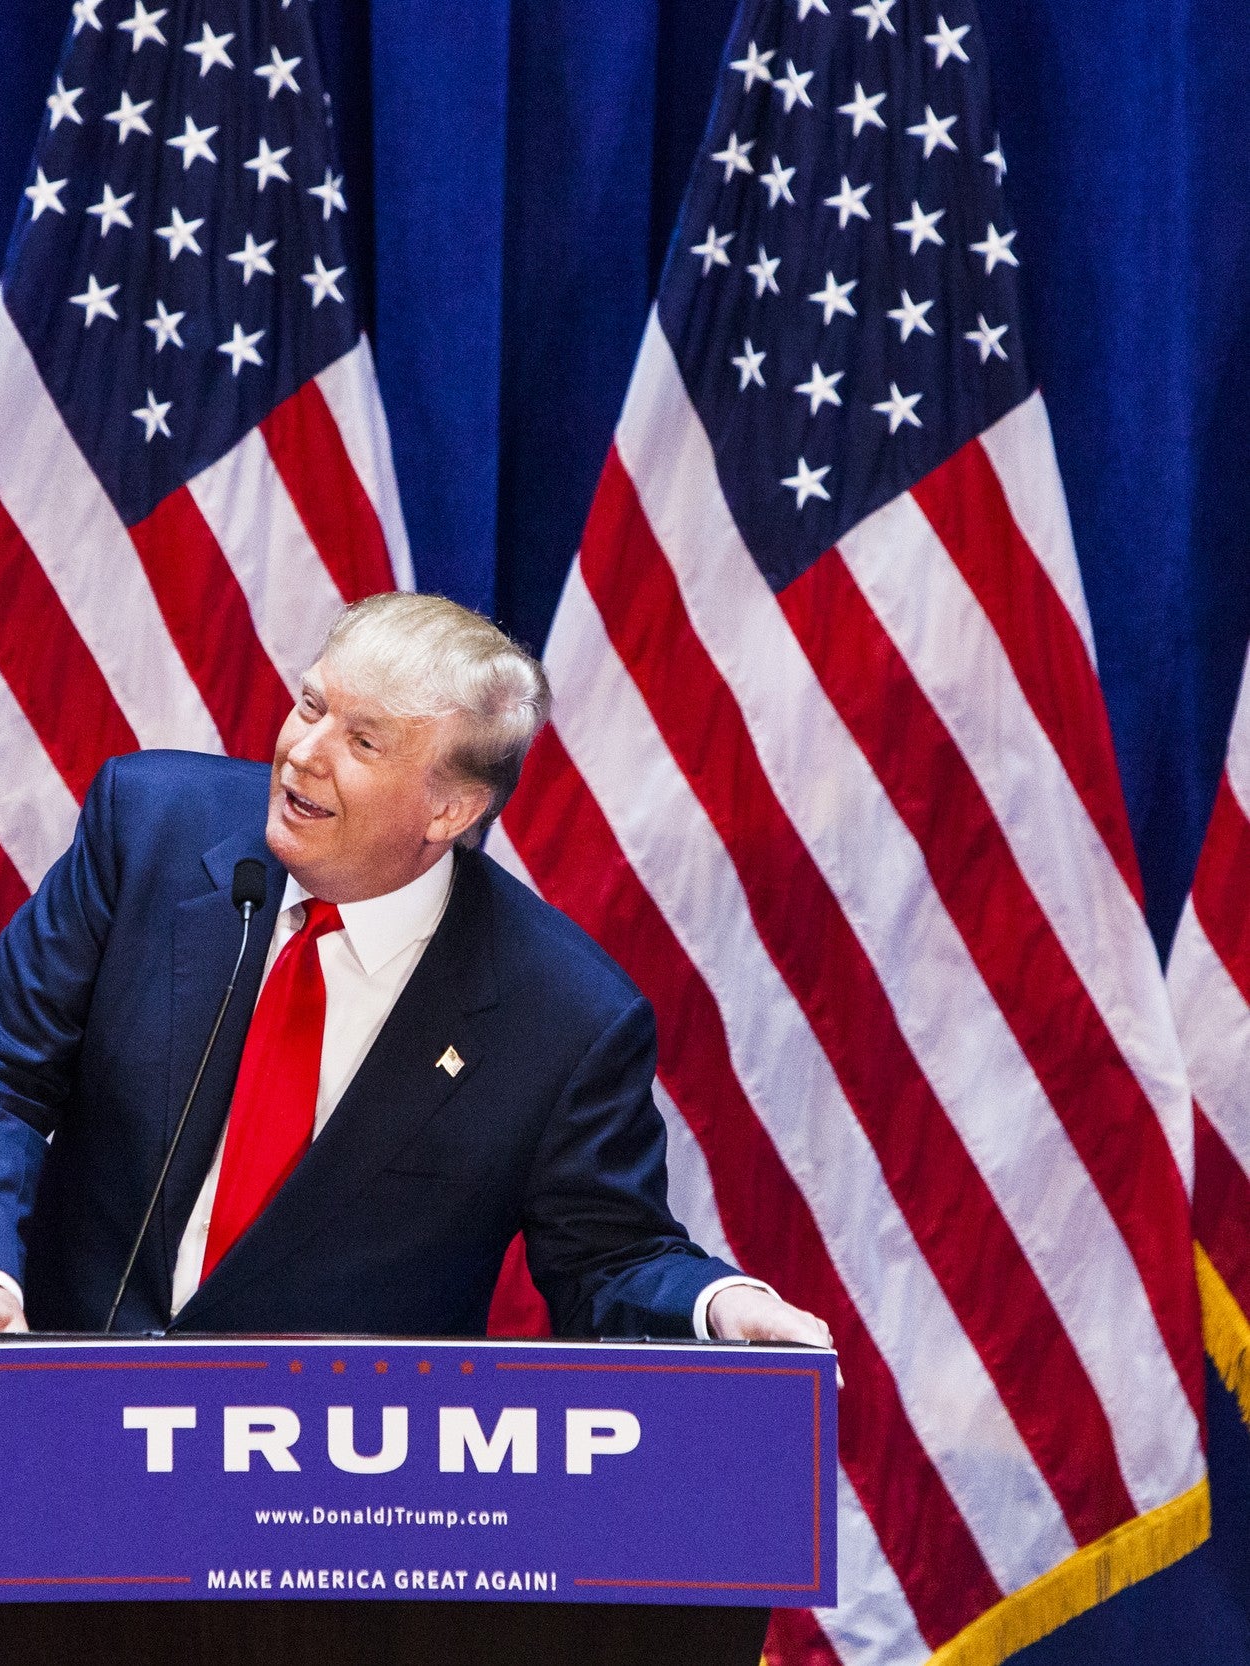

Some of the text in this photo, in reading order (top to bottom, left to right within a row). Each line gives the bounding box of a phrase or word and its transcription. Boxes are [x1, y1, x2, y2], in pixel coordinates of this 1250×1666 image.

[122, 1406, 641, 1475] TRUMP
[255, 1506, 508, 1528] www.DonaldJTrump.com
[207, 1569, 558, 1591] MAKE AMERICA GREAT AGAIN!
